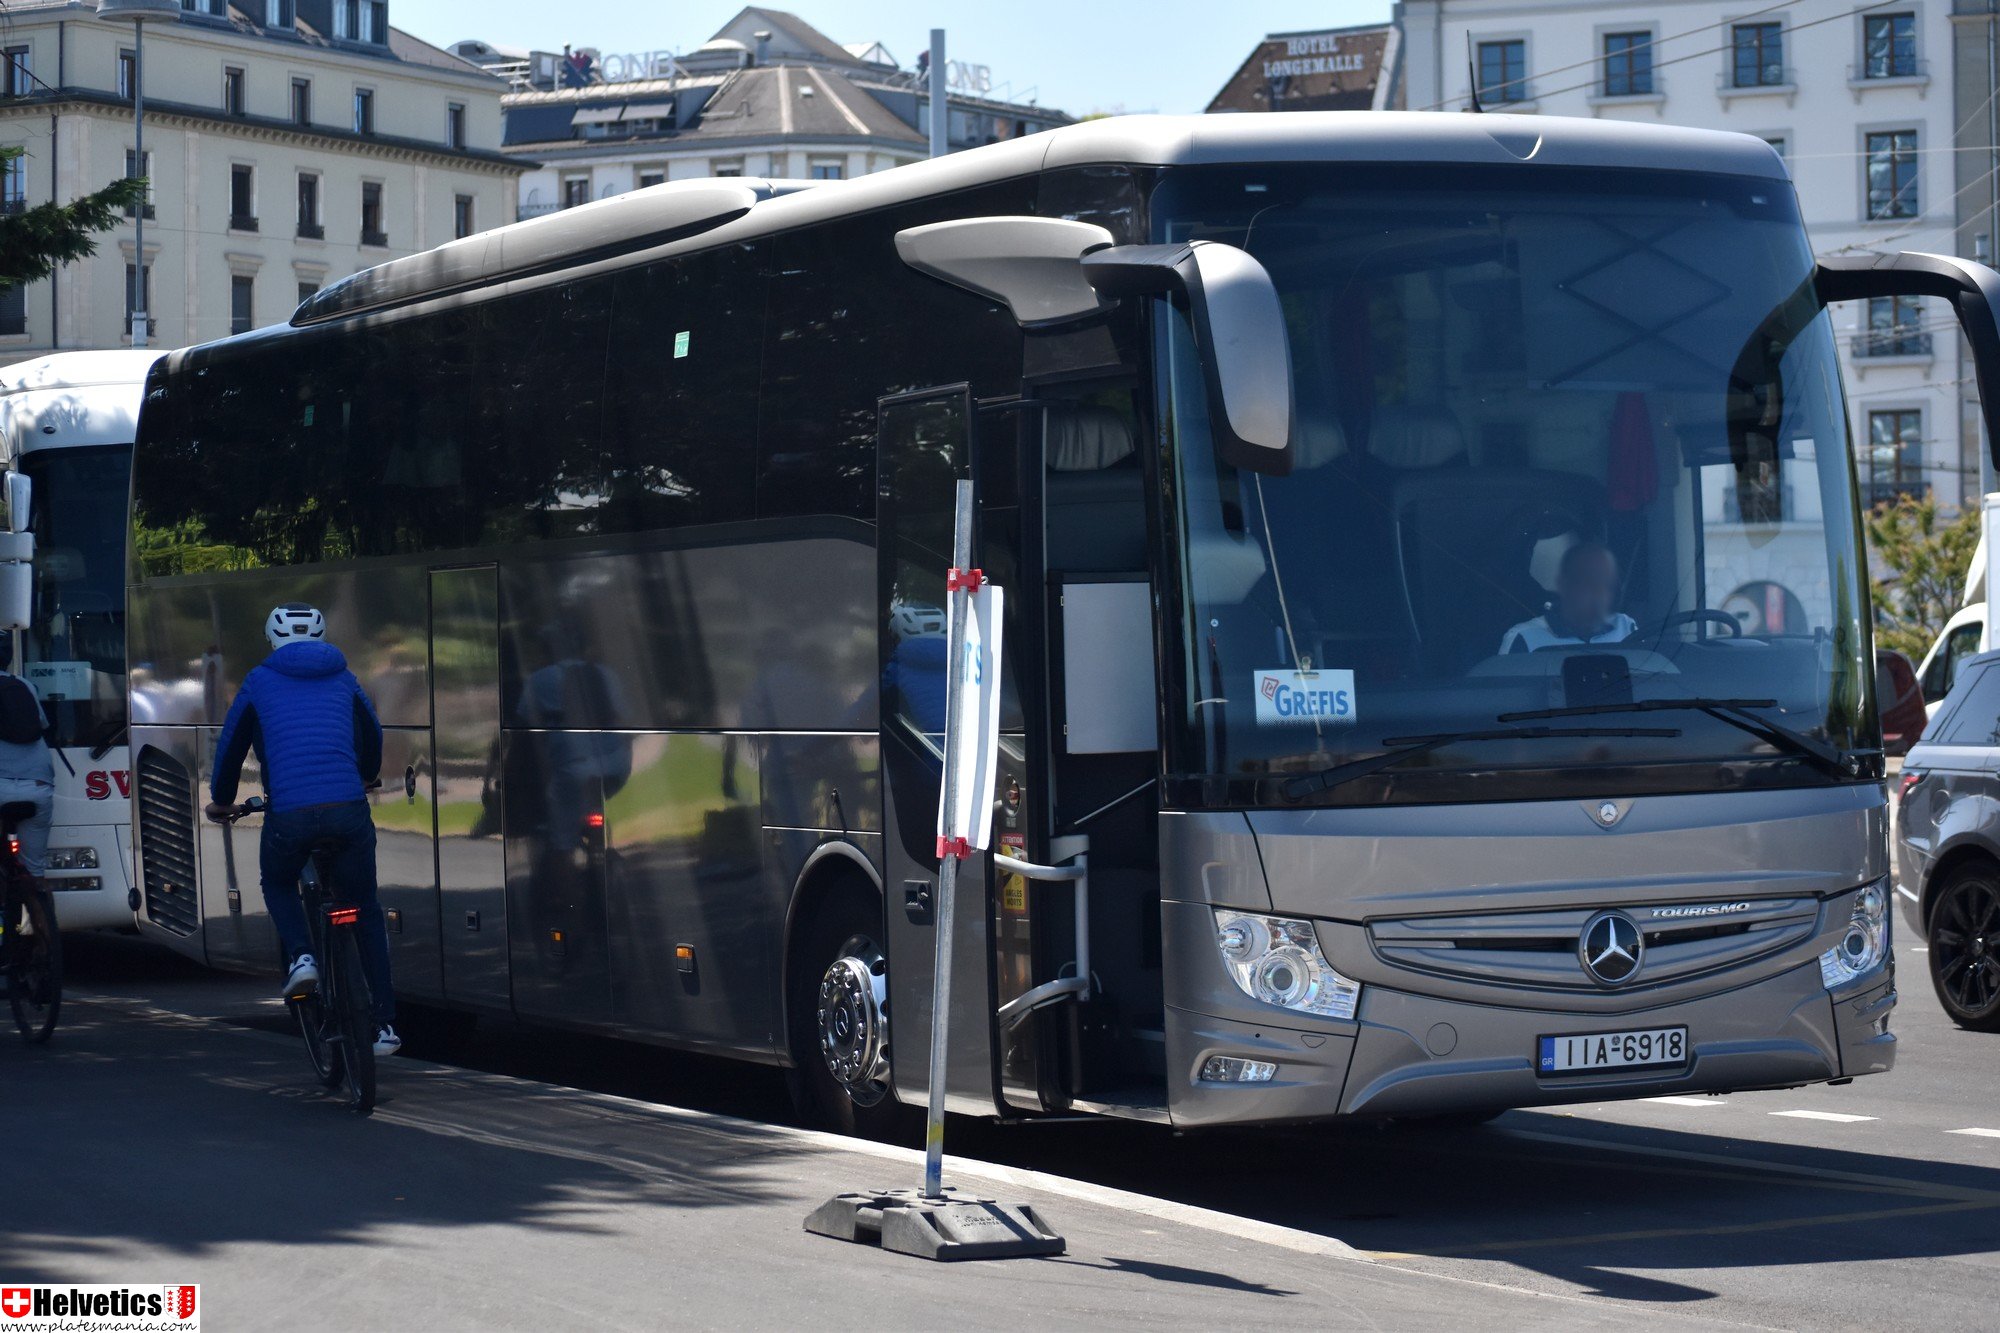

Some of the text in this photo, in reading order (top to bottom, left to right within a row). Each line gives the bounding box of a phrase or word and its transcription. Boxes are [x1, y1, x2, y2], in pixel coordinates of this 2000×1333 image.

[1286, 36, 1339, 56] HOTEL
[601, 50, 677, 84] QNB
[1263, 53, 1364, 78] LONGEMALLE
[1274, 684, 1349, 717] GREFIS
[1651, 902, 1750, 918] TOURISMO
[1541, 1057, 1553, 1066] GR
